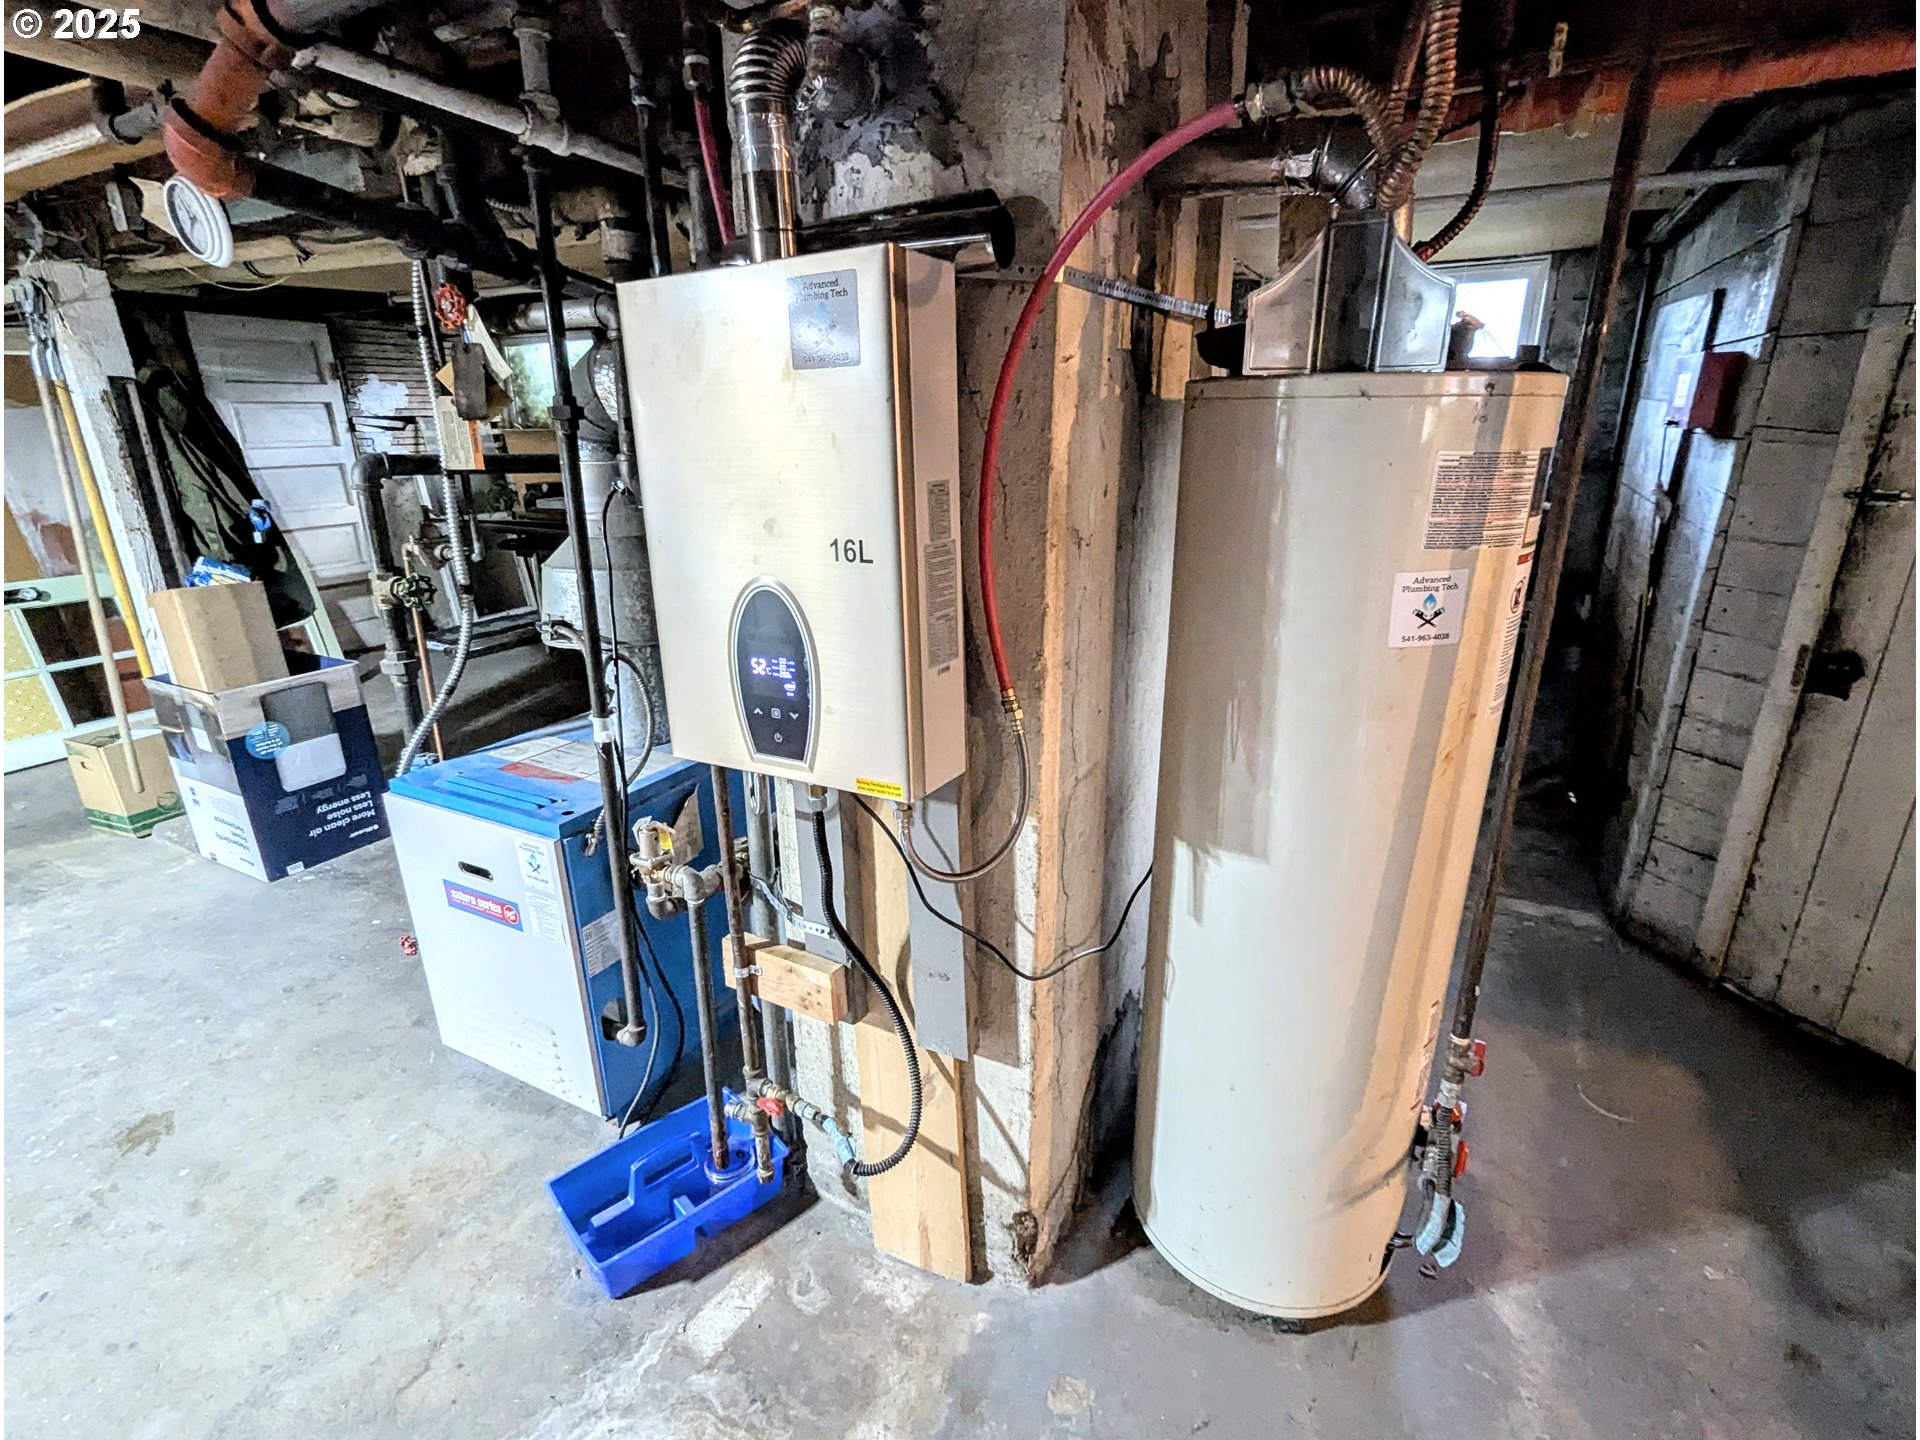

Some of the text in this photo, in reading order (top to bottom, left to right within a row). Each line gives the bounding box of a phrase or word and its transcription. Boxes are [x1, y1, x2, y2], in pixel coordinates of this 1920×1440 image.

[803, 278, 839, 291] Advanced
[830, 288, 848, 298] Tech
[830, 538, 874, 564] 16L
[1412, 574, 1452, 584] Advanced
[1402, 582, 1459, 593] Plumbing Tech
[1401, 633, 1450, 643] 541-963-4038
[350, 790, 371, 802] Less
[316, 798, 350, 814] energy
[326, 800, 373, 820] Less noise
[308, 808, 376, 837] More clean air
[450, 889, 503, 914] saturn series
